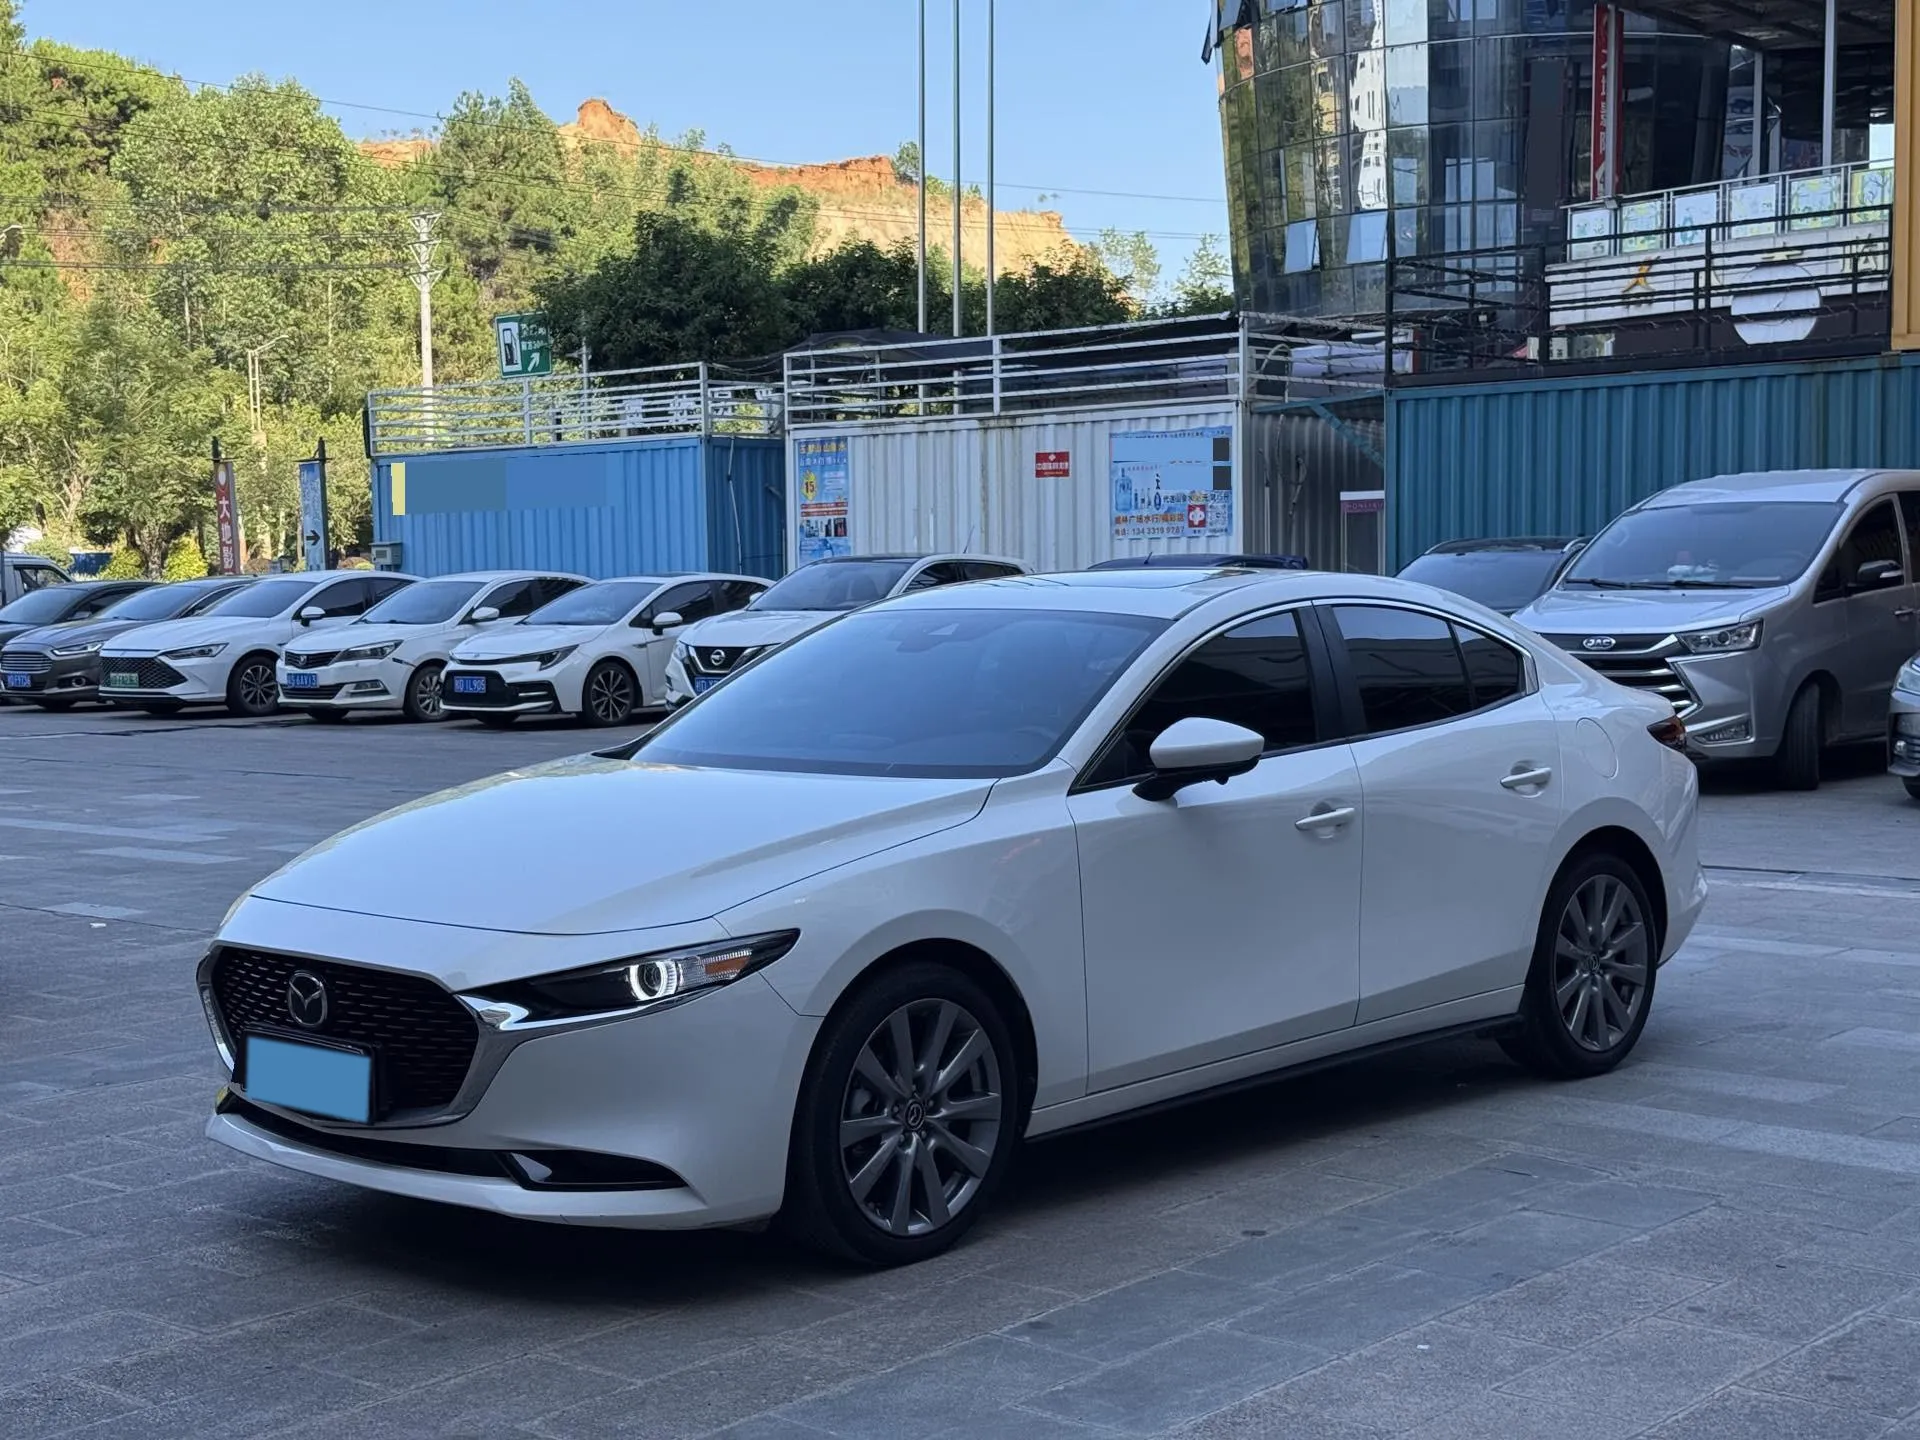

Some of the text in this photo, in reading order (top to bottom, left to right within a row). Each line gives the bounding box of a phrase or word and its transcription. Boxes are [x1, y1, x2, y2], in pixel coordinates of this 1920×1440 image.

[804, 480, 815, 493] 15
[219, 496, 234, 574] 大地影
[1586, 637, 1612, 647] JAC
